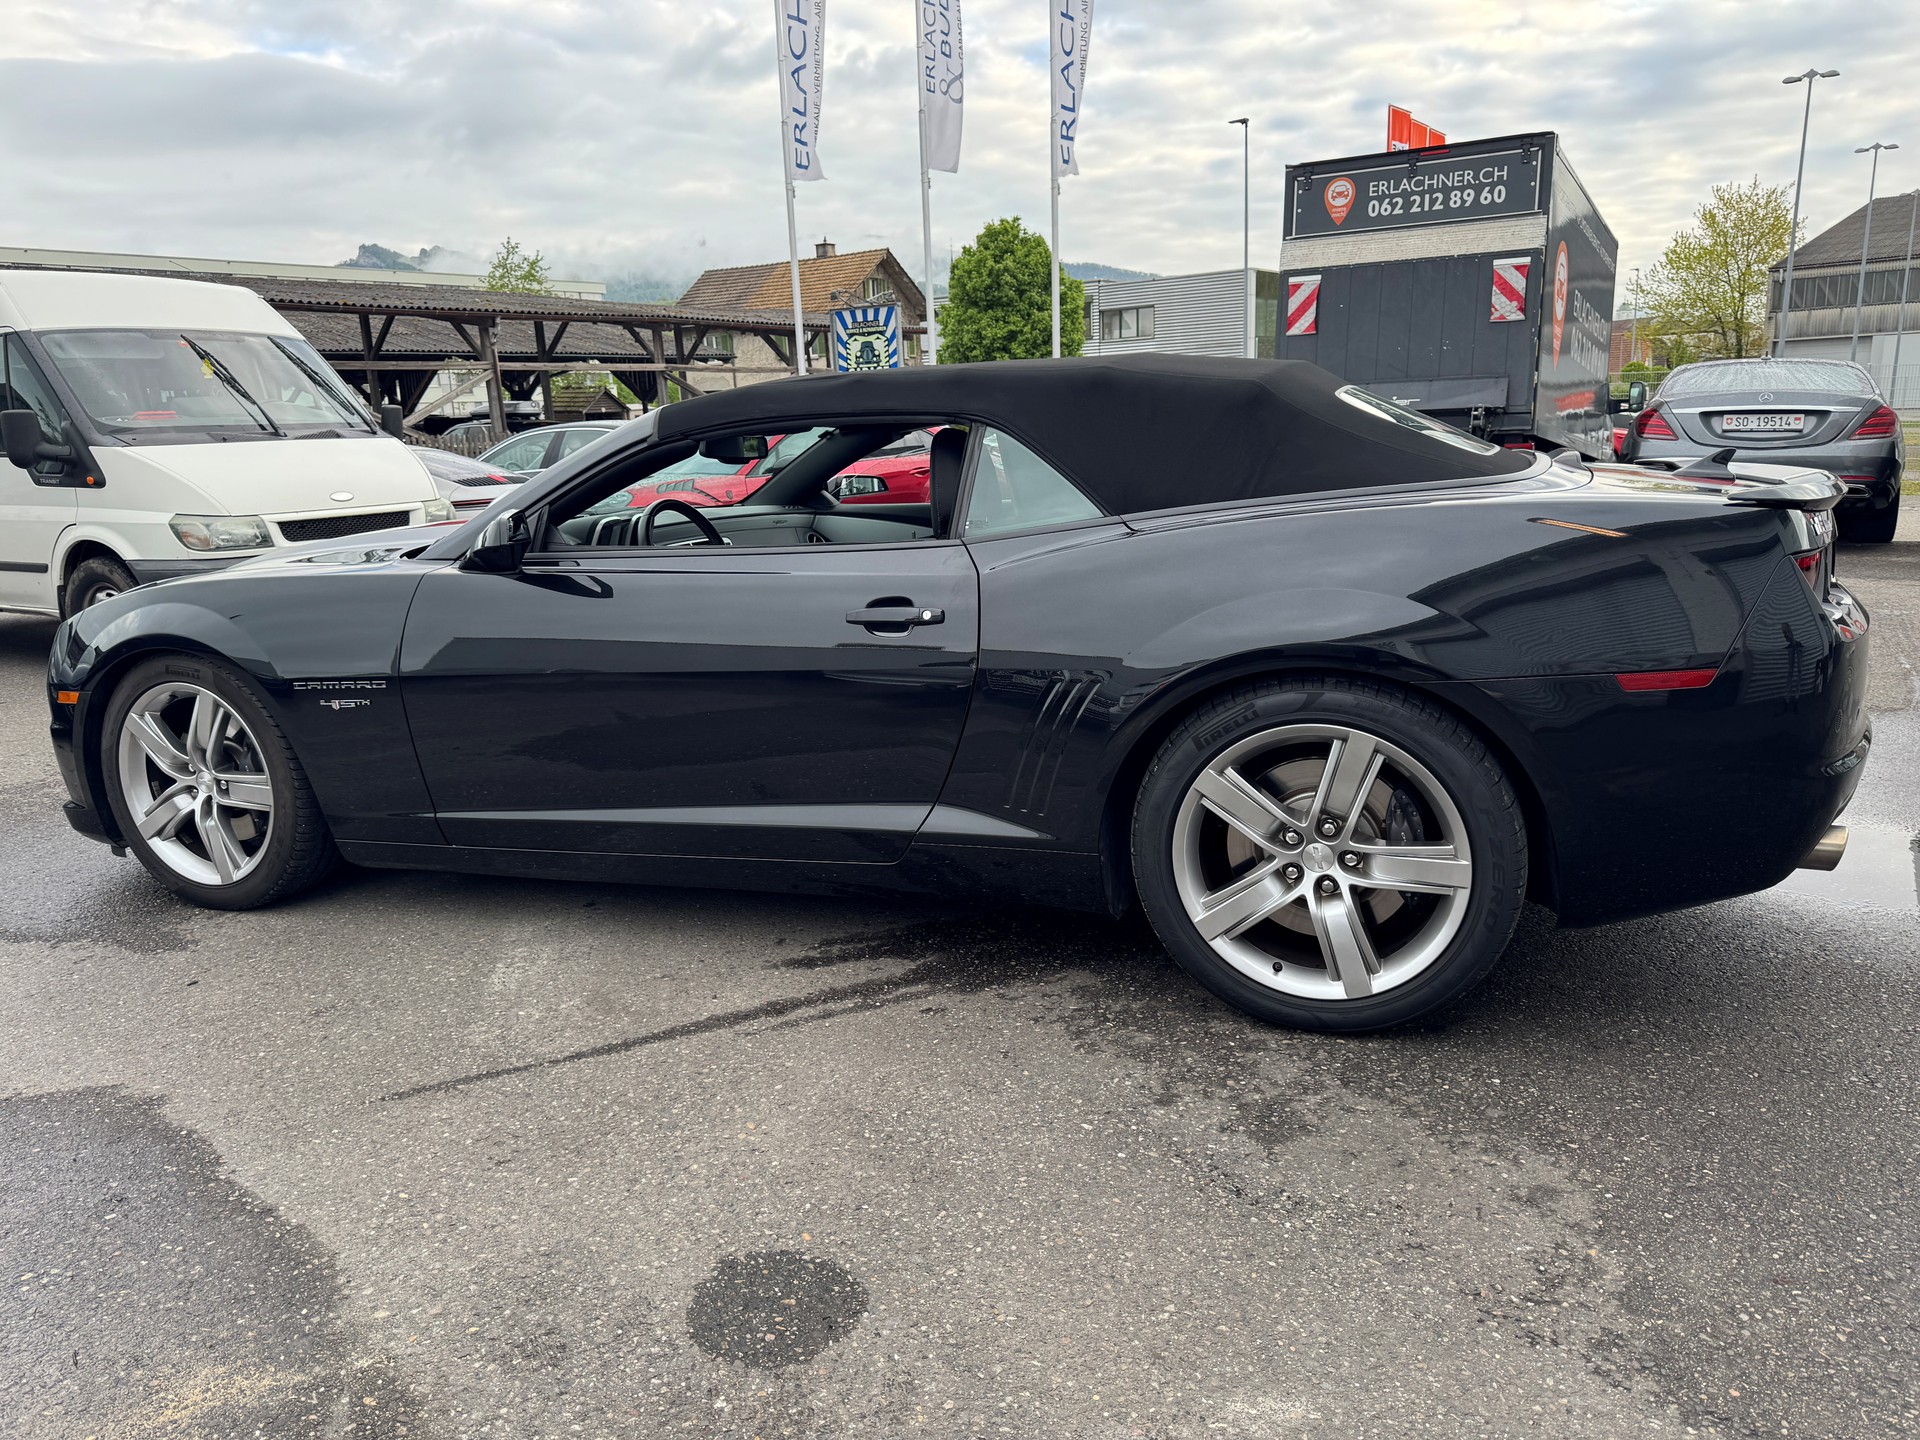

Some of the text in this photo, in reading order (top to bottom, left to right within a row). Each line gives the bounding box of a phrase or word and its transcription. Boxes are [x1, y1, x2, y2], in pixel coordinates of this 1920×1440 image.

[1369, 165, 1508, 197] ERLACHNER.CH
[1367, 185, 1506, 217] 062 212 89 60
[293, 680, 387, 690] CAMARO
[1191, 702, 1260, 752] PIRELLI
